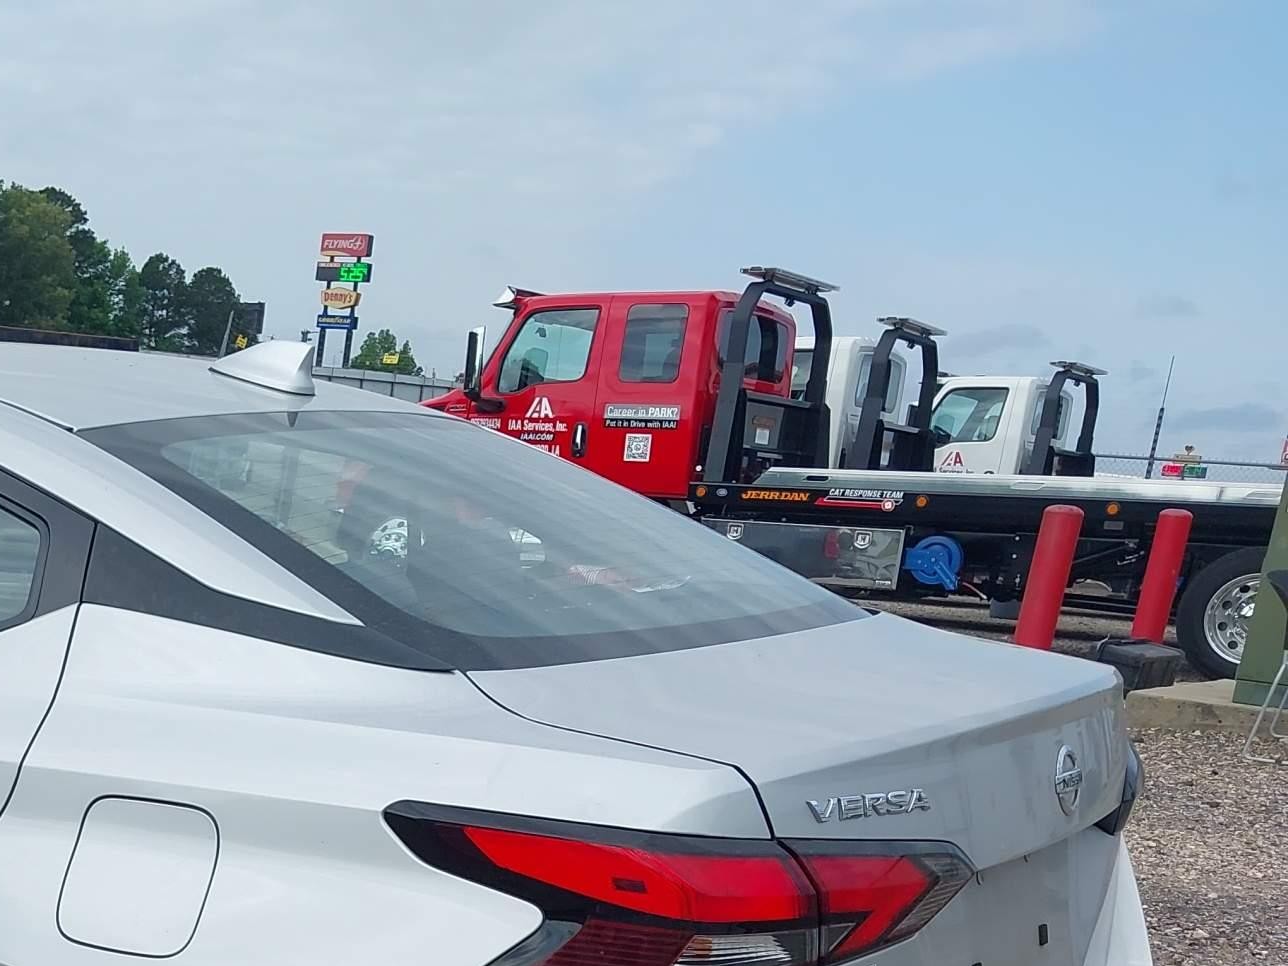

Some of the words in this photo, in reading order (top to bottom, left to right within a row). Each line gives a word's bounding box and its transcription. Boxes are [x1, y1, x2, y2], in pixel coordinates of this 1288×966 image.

[323, 239, 353, 249] FLYING
[323, 292, 353, 305] Denny's
[607, 406, 636, 417] Career
[638, 407, 646, 417] in
[648, 407, 678, 418] PARK?
[508, 419, 522, 431] IAA
[523, 420, 554, 433] Services,
[556, 421, 568, 431] Inc.
[630, 420, 646, 428] Drive
[647, 421, 661, 429] with
[520, 433, 554, 441] IAAI.COM
[829, 488, 844, 497] CAT
[845, 489, 881, 498] RESPONSE
[882, 489, 904, 499] TEAM
[805, 787, 931, 823] VERSA
